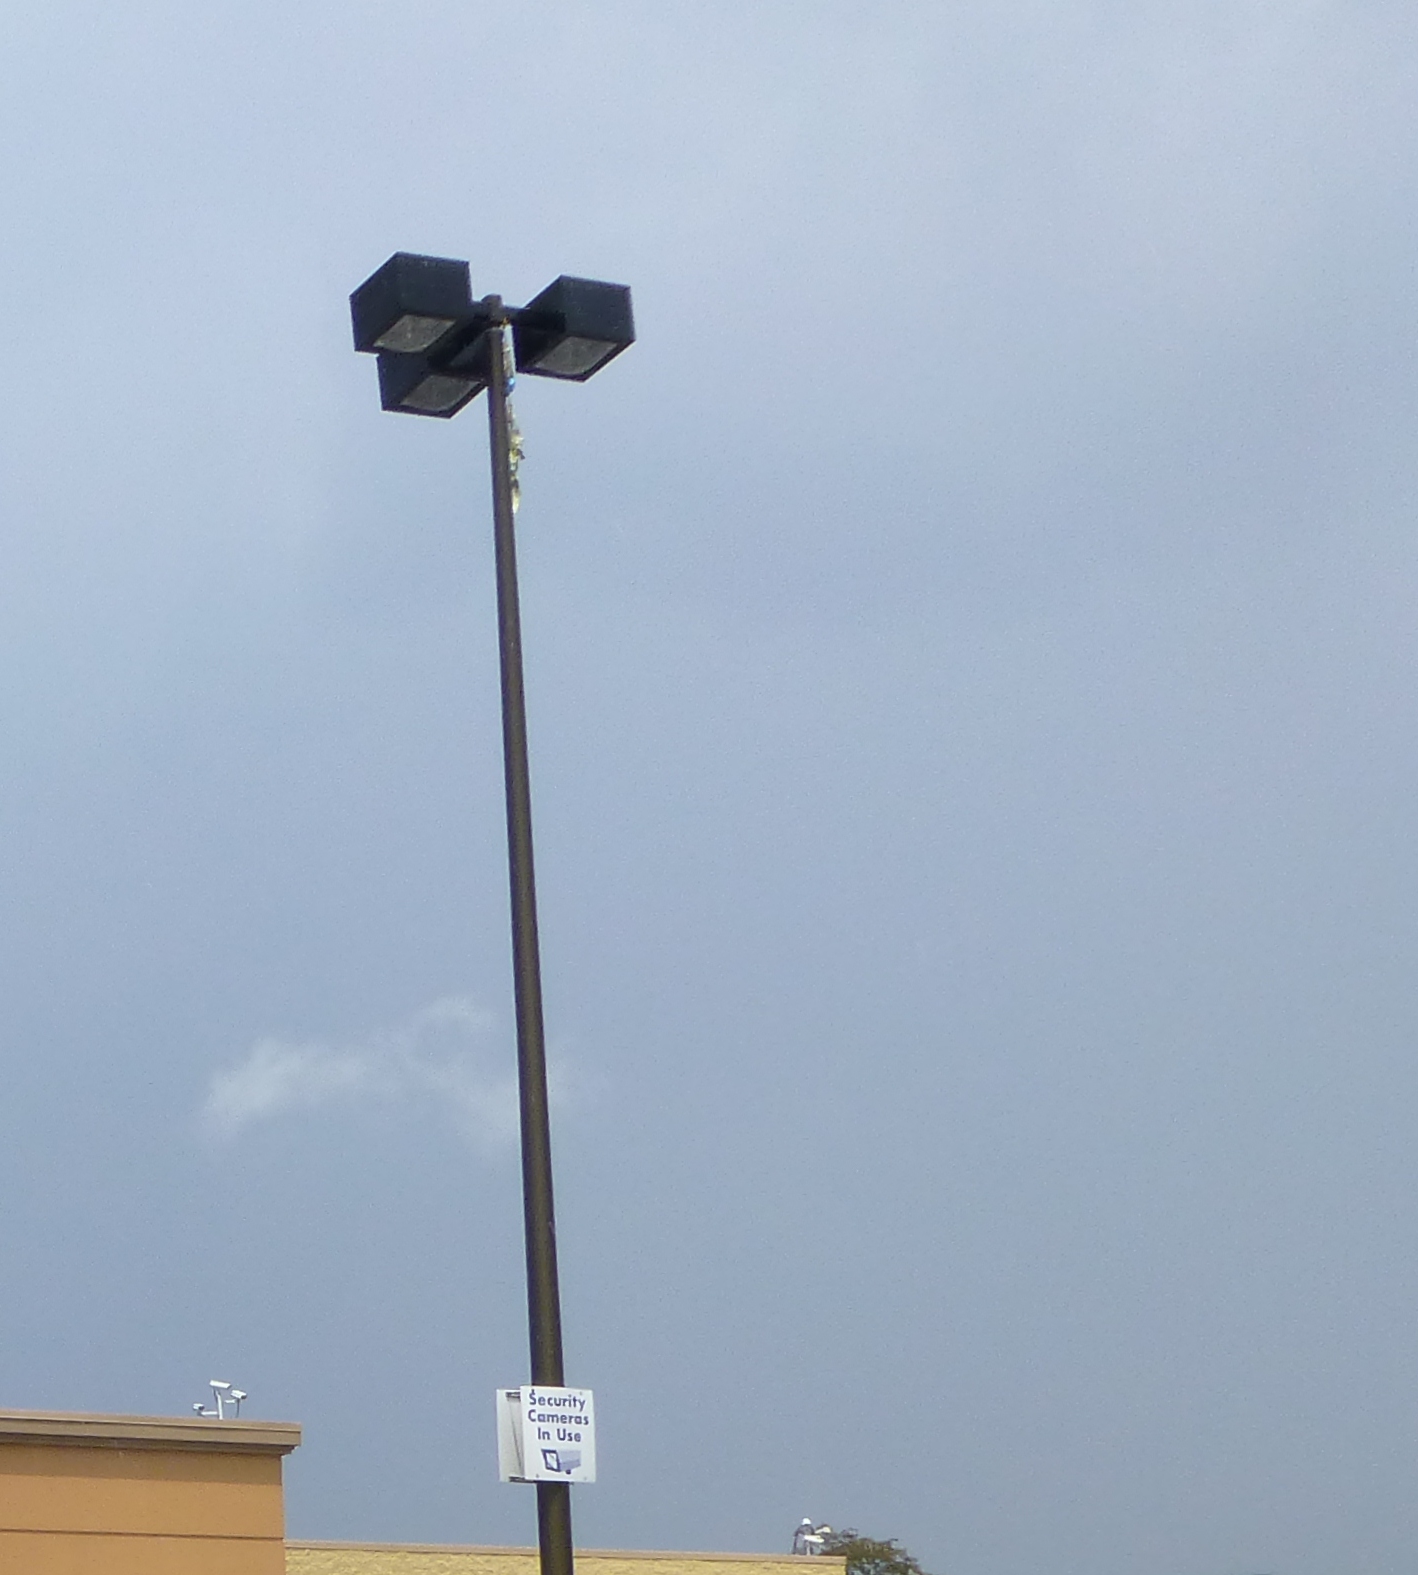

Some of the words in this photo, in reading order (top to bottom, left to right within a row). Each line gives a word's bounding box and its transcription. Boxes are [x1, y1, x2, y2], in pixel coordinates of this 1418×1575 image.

[528, 1392, 586, 1412] Security
[527, 1409, 590, 1426] Cameras
[537, 1427, 551, 1441] In
[556, 1428, 582, 1442] Use
